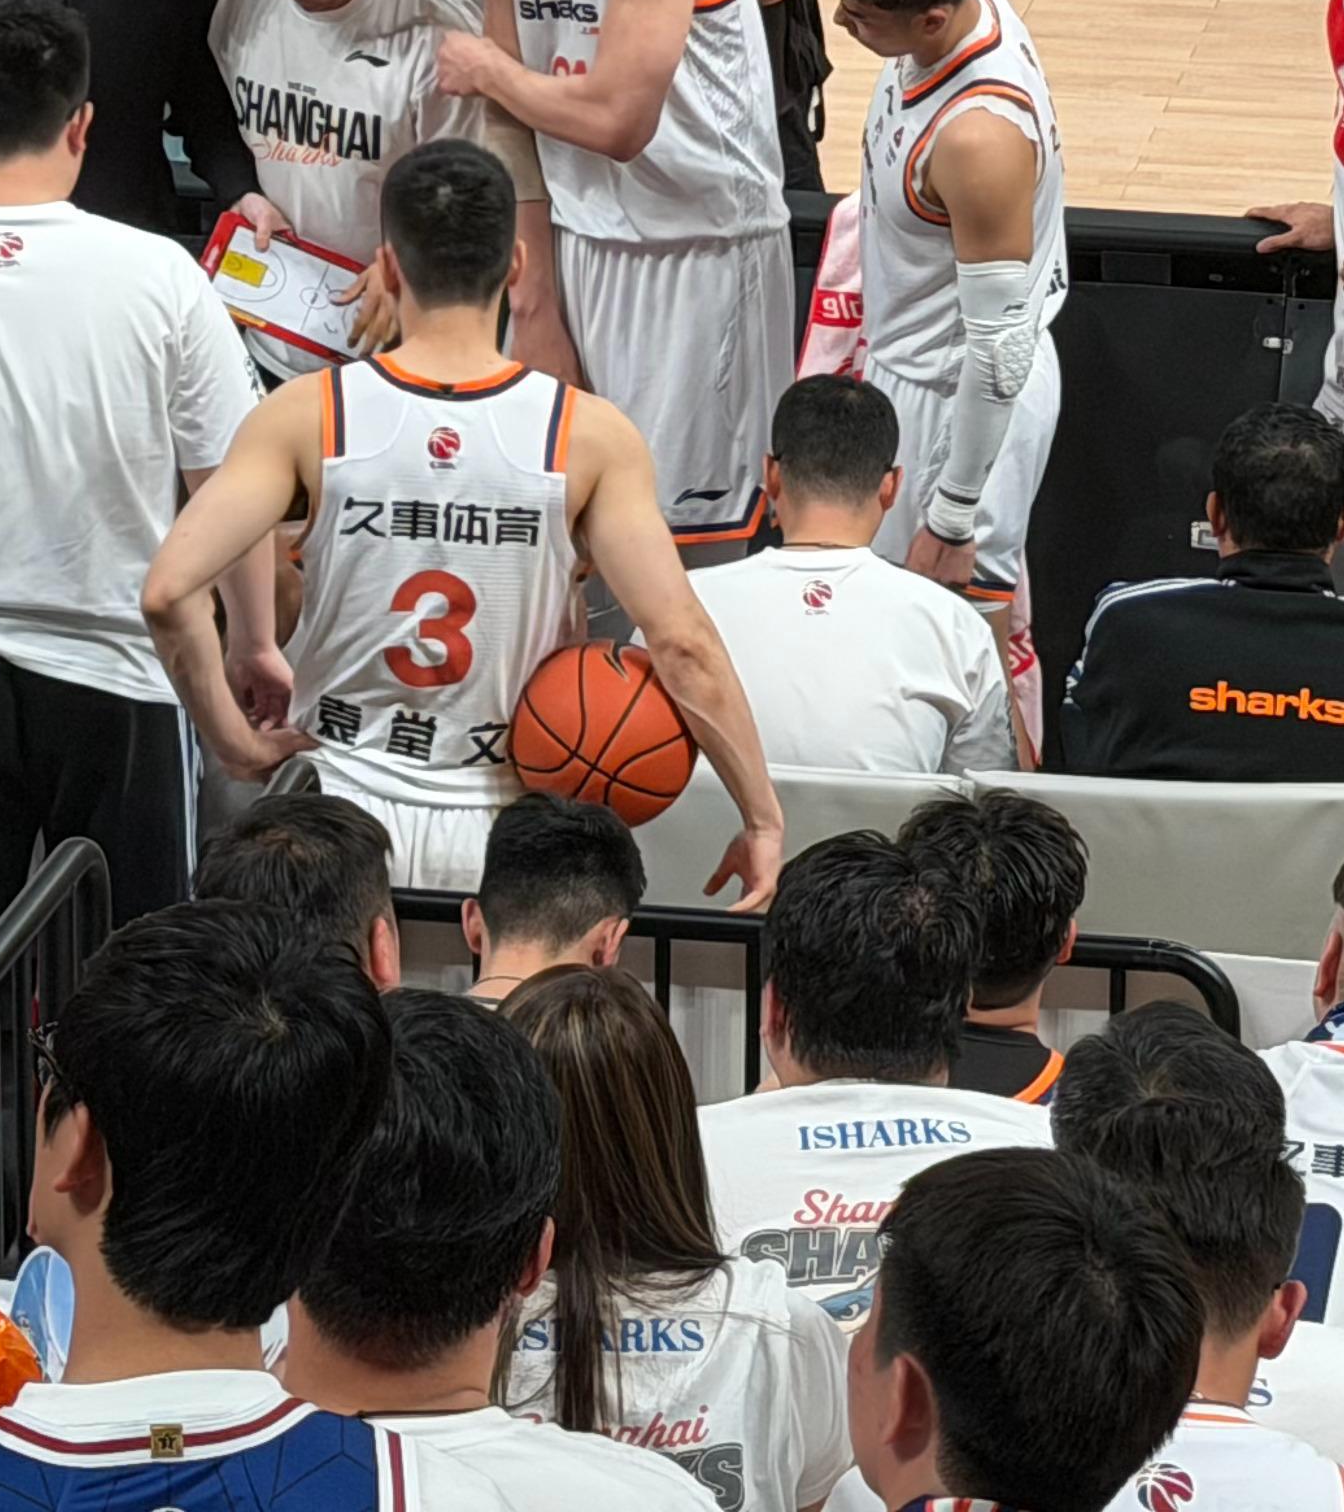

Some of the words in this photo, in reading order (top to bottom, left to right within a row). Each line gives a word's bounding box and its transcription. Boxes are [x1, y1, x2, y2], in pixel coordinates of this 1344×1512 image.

[235, 76, 382, 161] SHANGHAI
[339, 496, 542, 547] 久事体育
[383, 569, 477, 688] 3
[798, 1117, 973, 1151] ISHARKS
[793, 1188, 899, 1225] Shan
[740, 1226, 892, 1288] SHA
